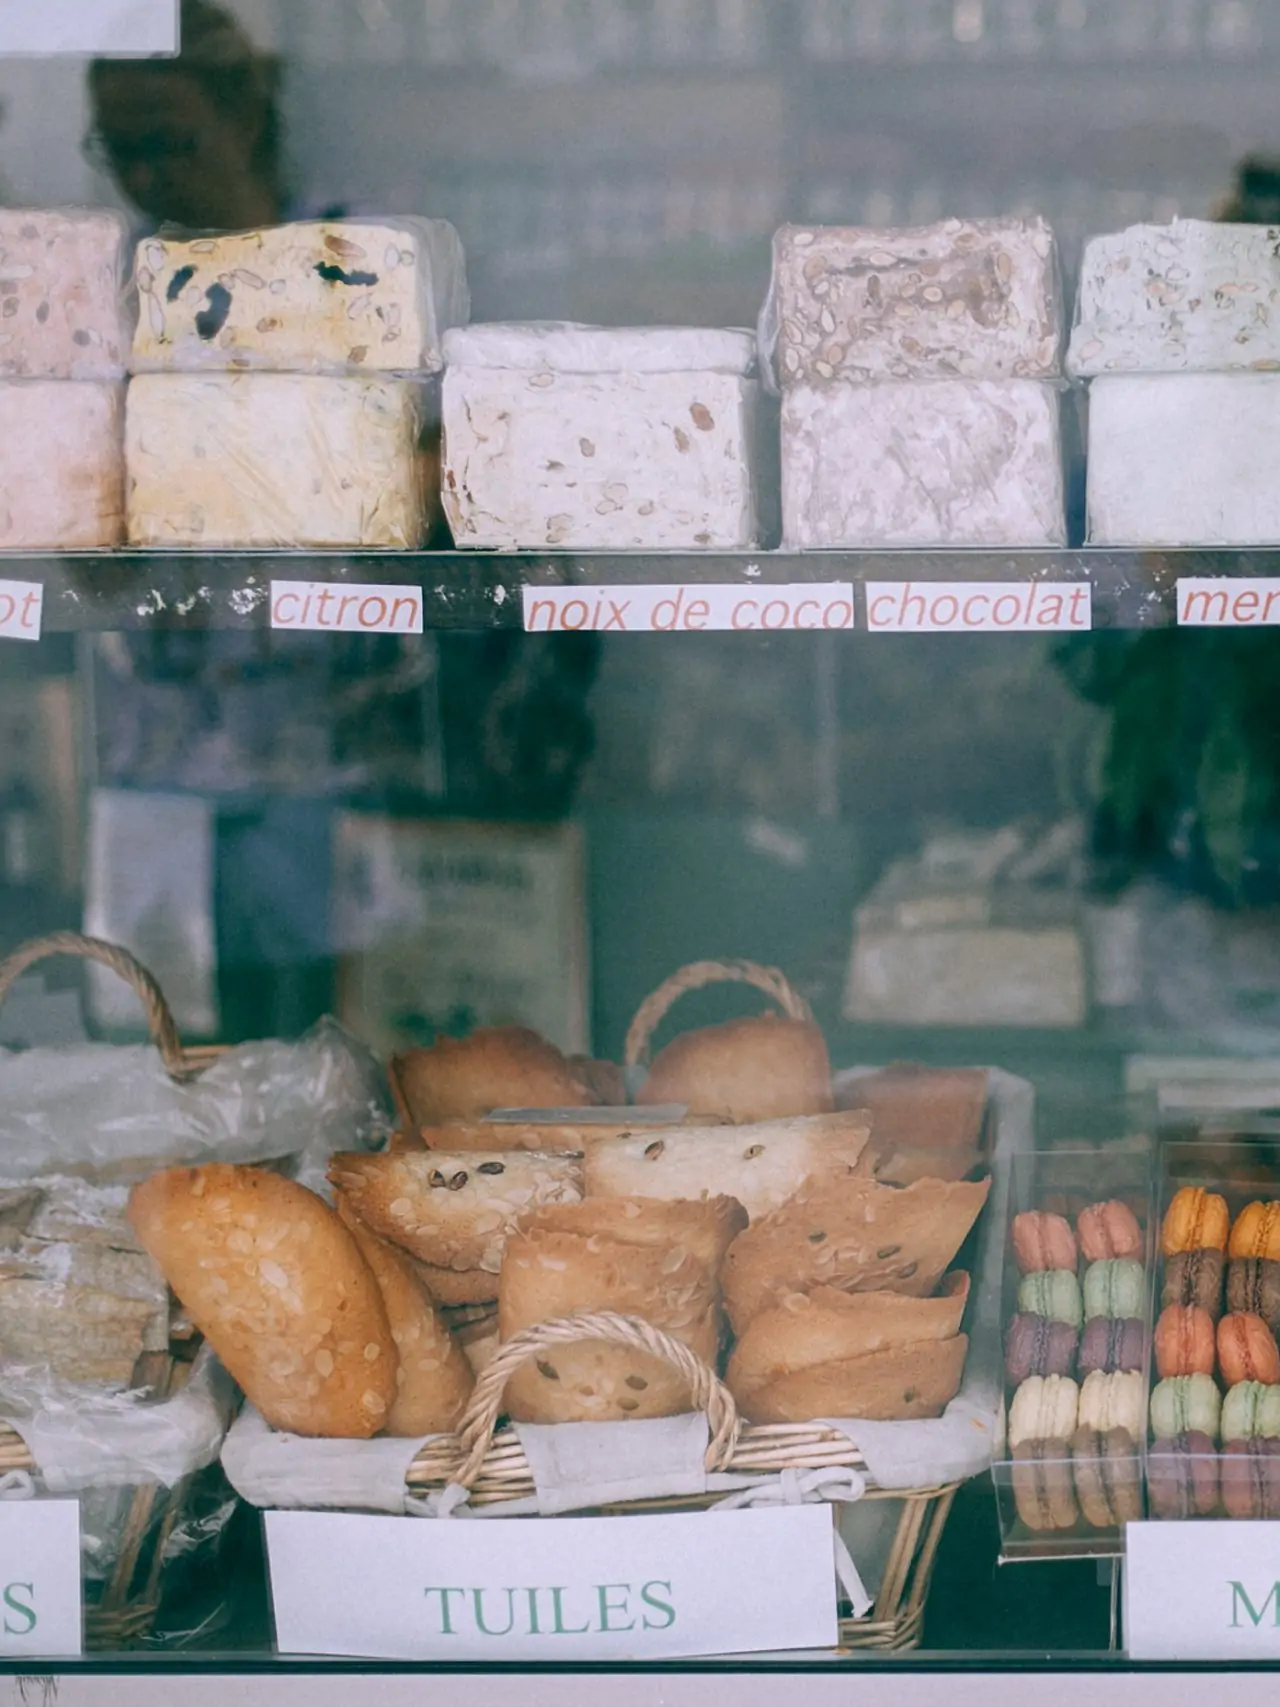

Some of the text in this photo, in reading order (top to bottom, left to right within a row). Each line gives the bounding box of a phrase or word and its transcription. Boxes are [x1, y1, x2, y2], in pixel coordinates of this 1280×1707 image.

[272, 584, 419, 628] citron
[526, 588, 852, 631] noix de coco
[868, 583, 1089, 626] chocolat
[424, 1579, 677, 1637] TUILES
